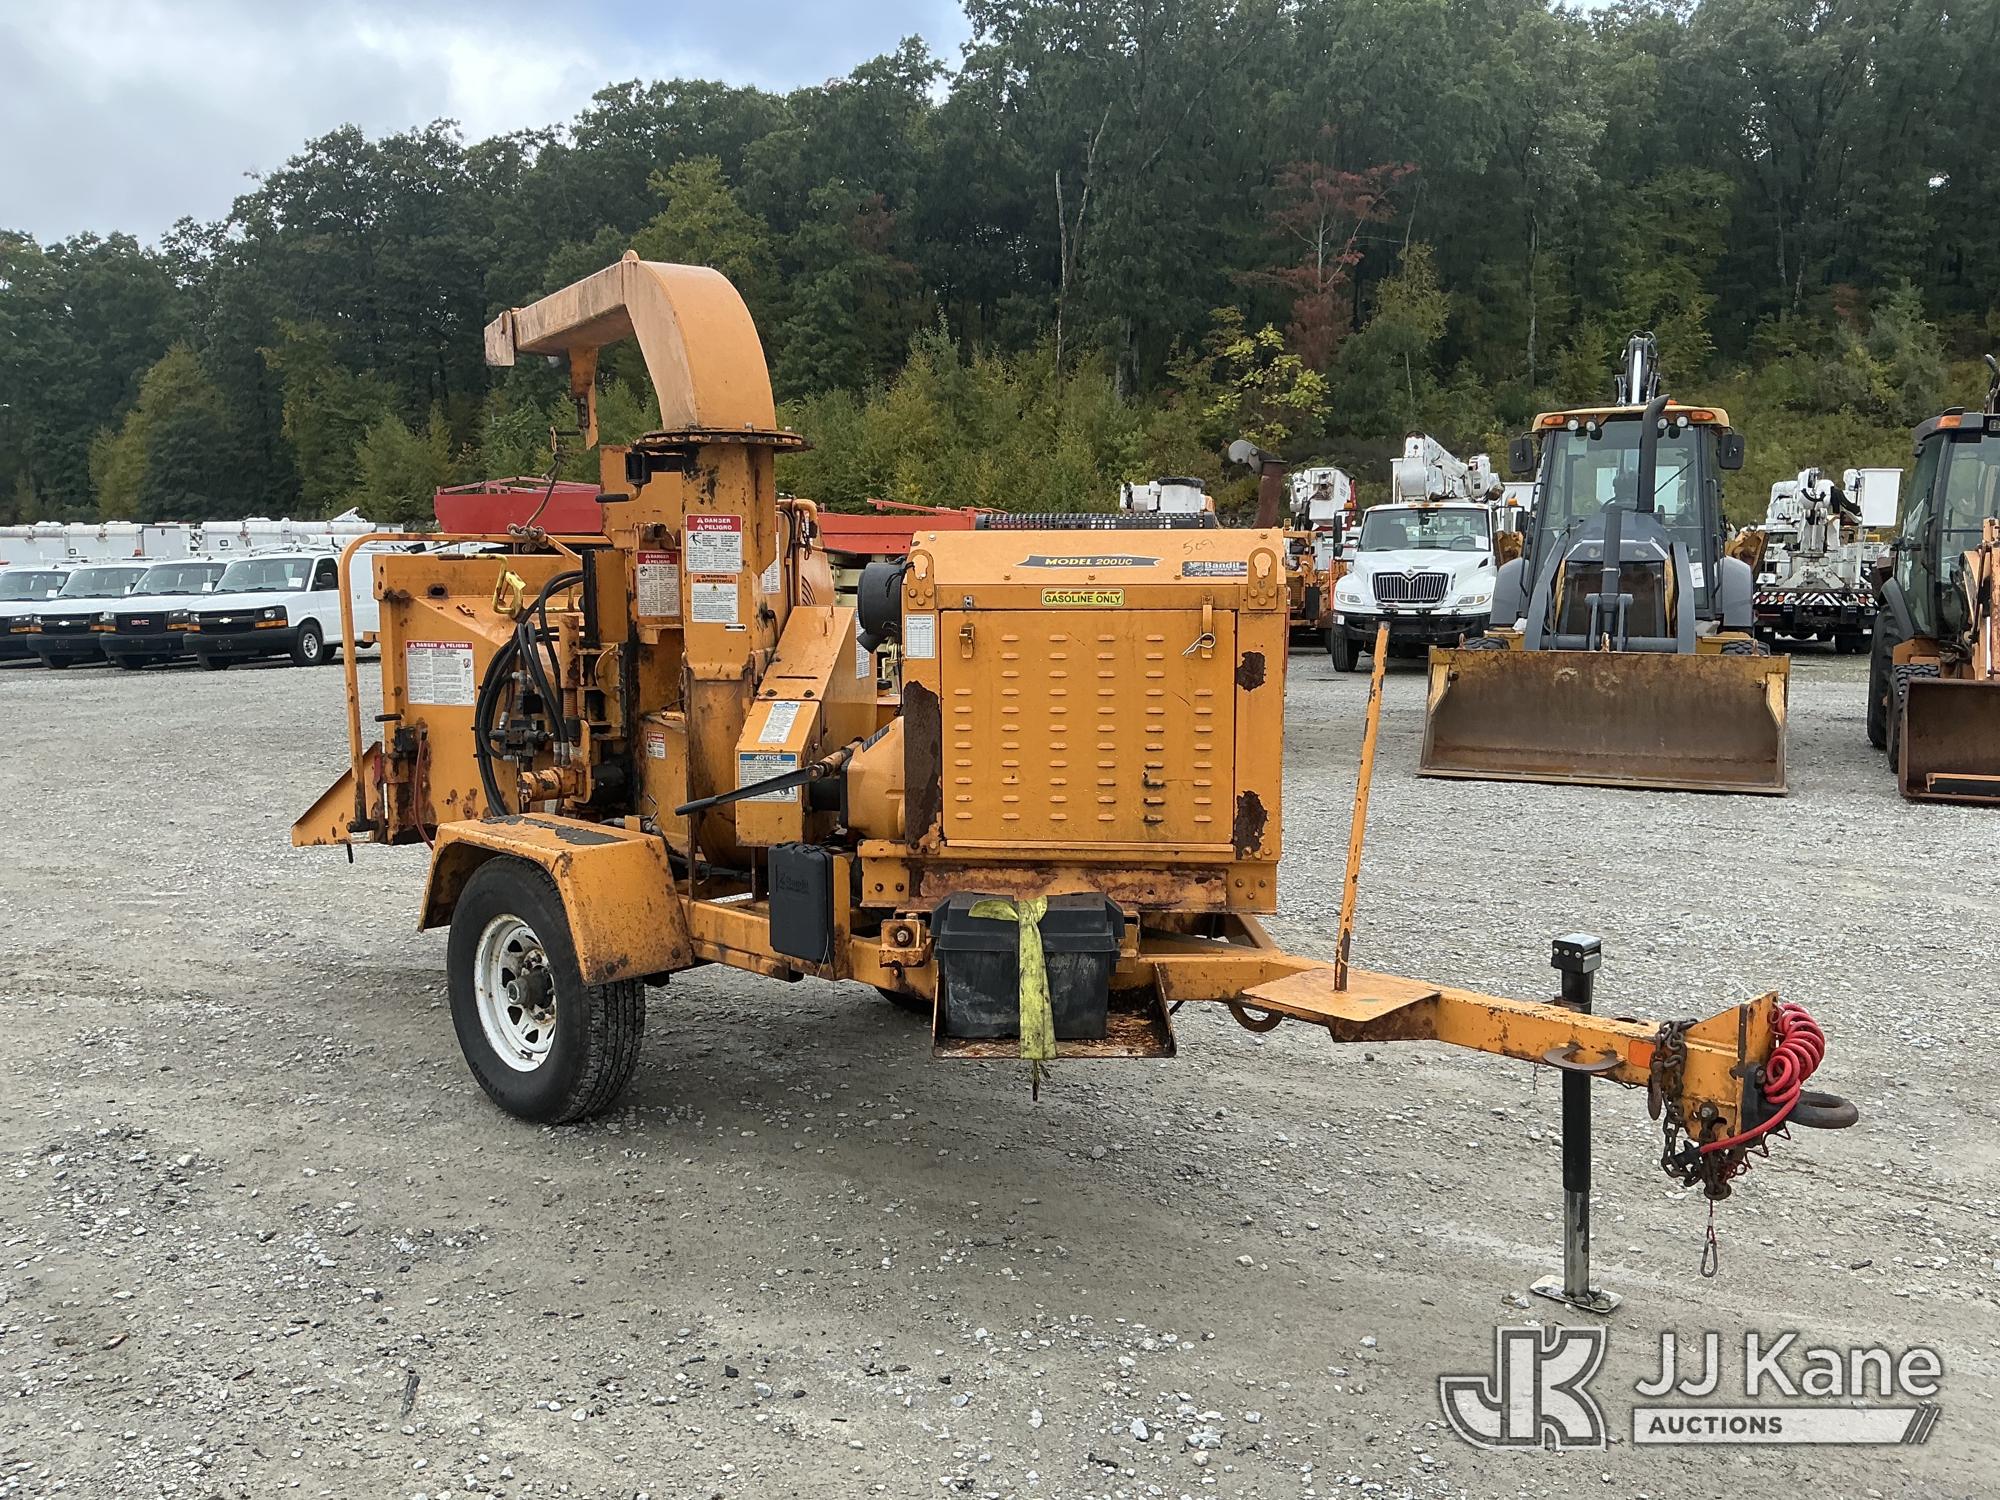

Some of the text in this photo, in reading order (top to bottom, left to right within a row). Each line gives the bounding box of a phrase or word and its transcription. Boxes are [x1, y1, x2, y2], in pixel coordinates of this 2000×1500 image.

[1044, 558, 1133, 566] MODEL 200UC
[1204, 561, 1240, 570] Bandit
[1044, 595, 1121, 604] GASOLINE ONLY
